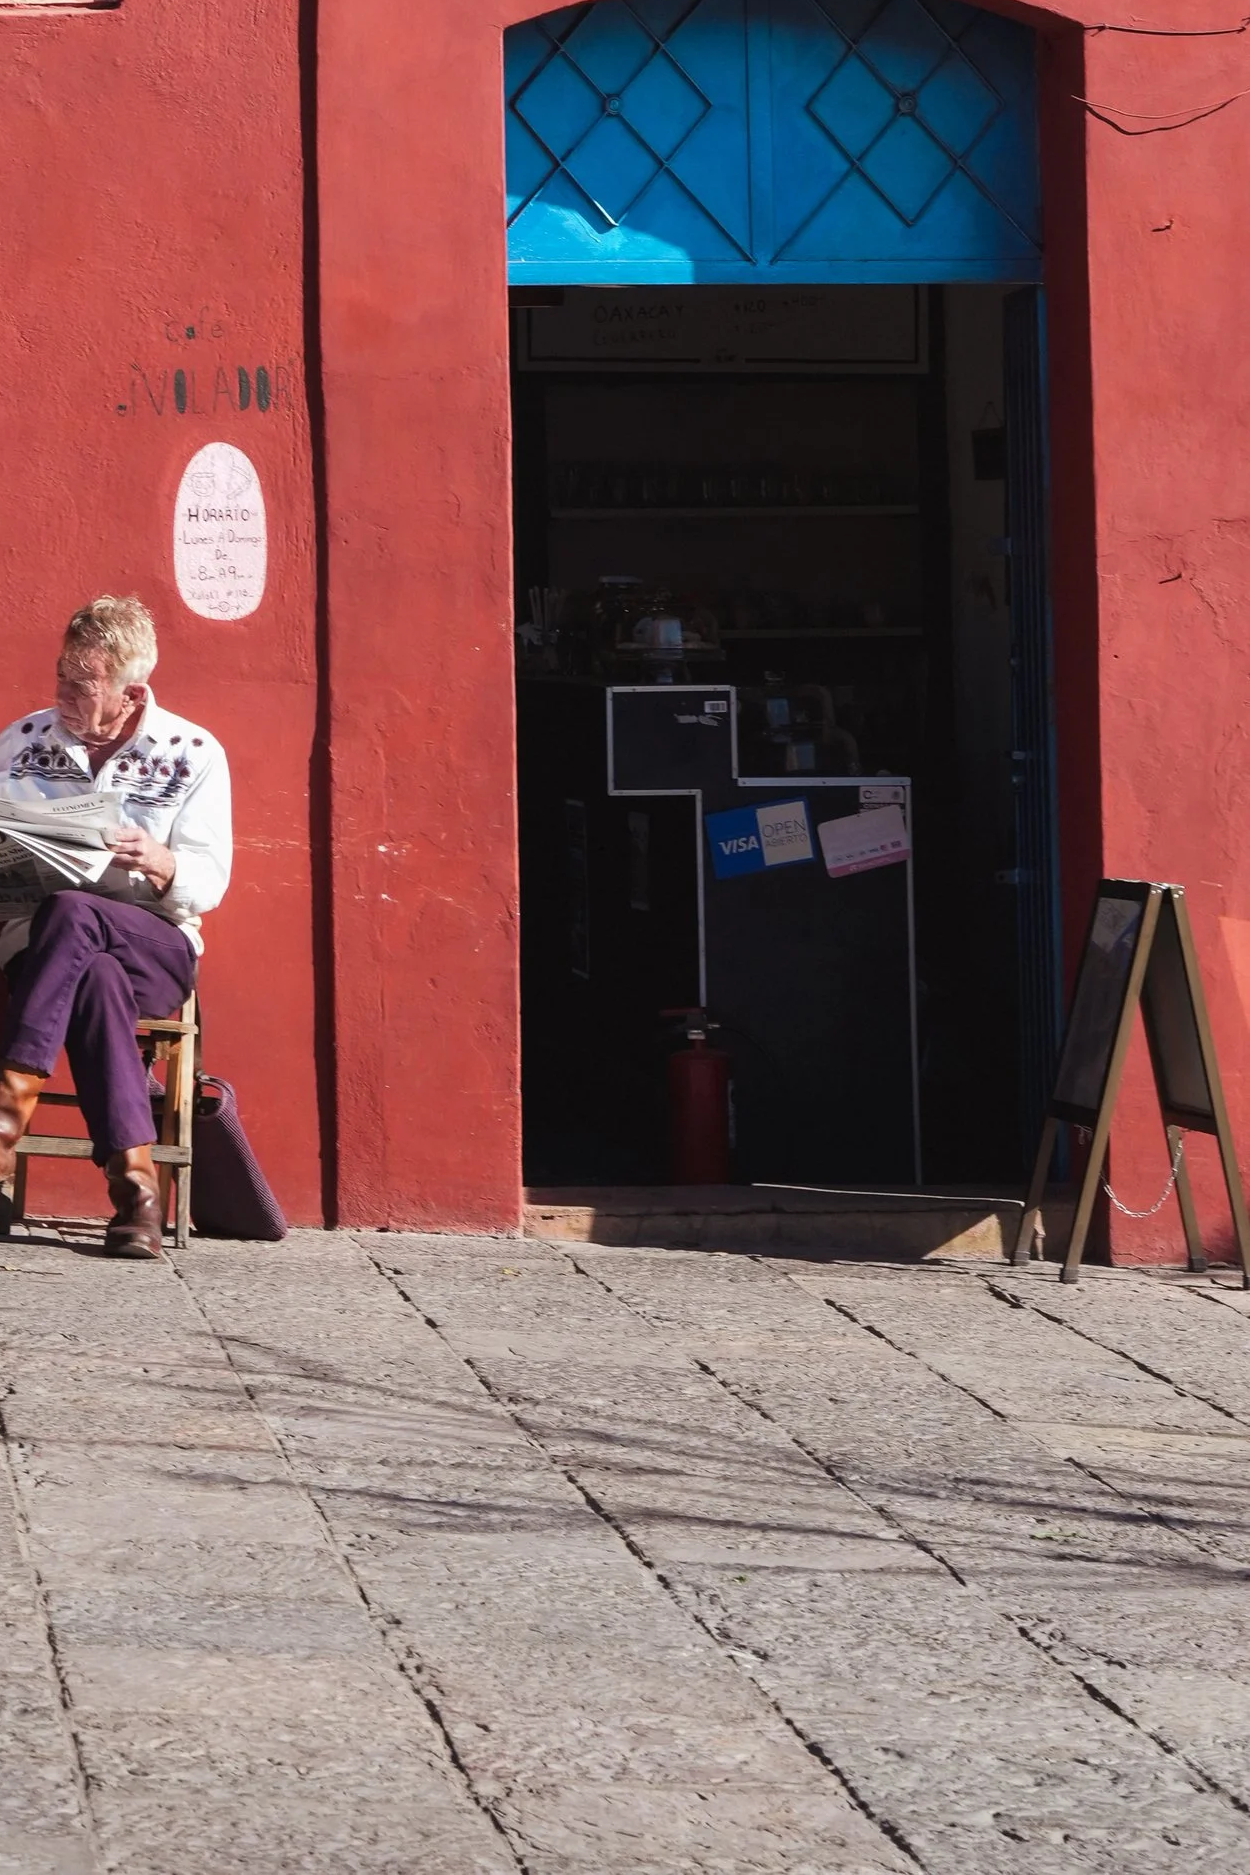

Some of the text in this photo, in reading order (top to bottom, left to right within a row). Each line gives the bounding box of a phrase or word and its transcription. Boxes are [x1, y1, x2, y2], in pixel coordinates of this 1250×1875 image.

[593, 304, 671, 324] OAXACA
[186, 508, 251, 523] HORARIO
[762, 818, 807, 839] OPEN
[717, 834, 761, 856] VISA
[765, 833, 808, 848] ABIERTO
